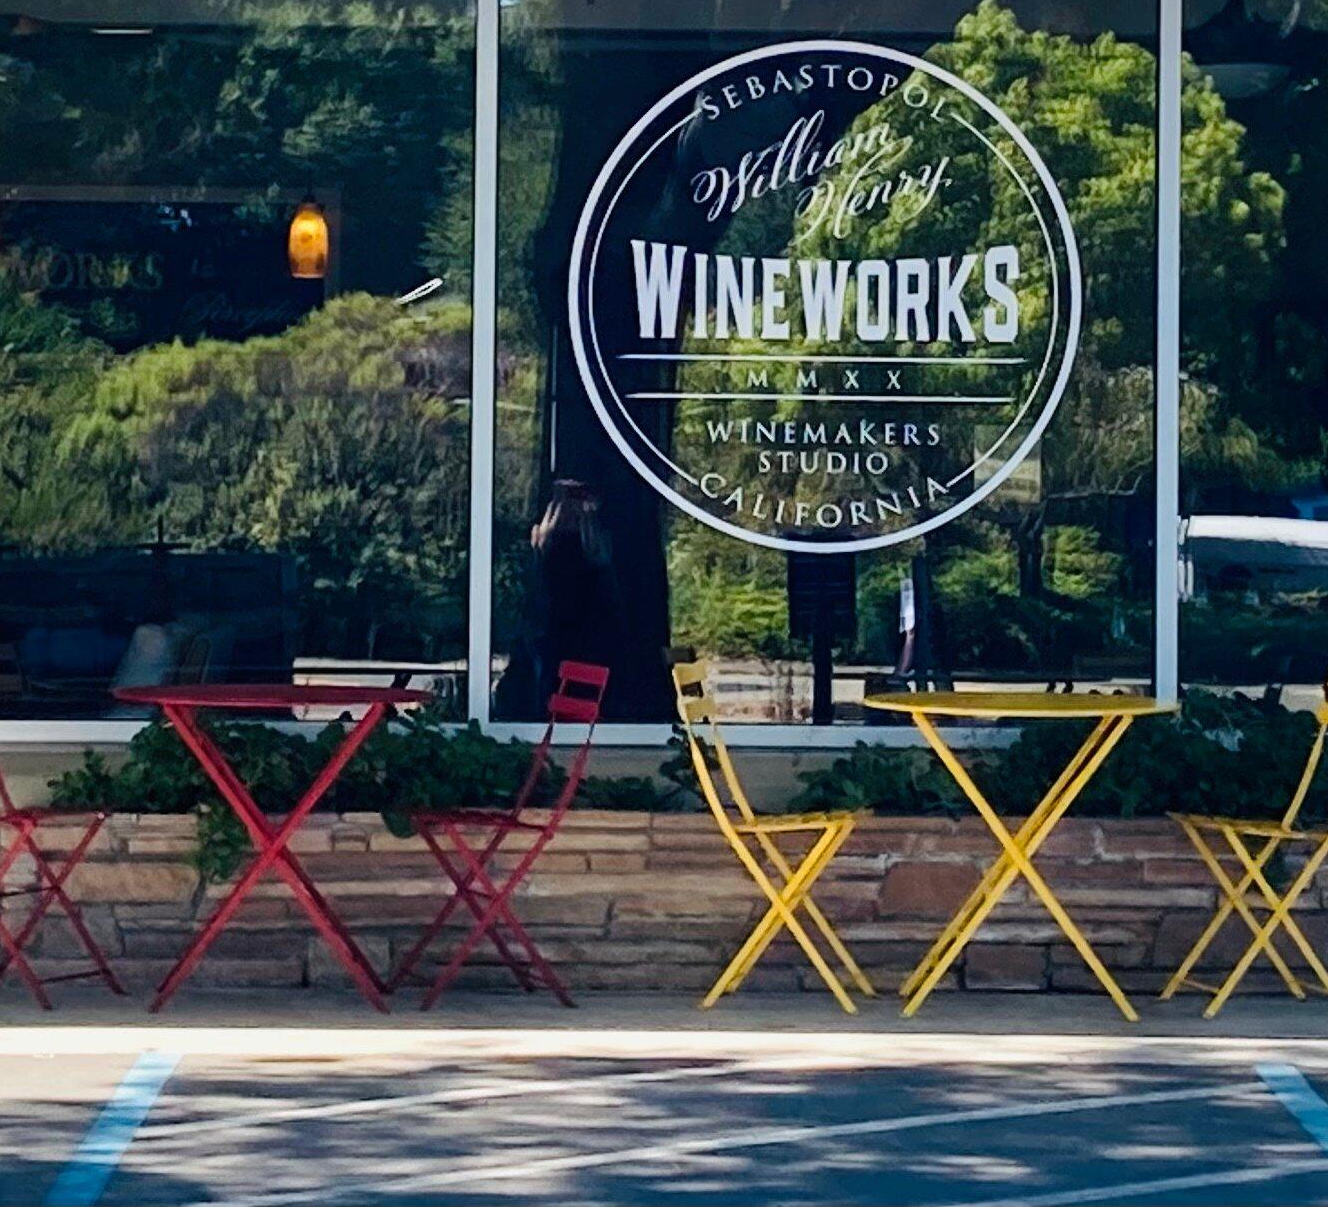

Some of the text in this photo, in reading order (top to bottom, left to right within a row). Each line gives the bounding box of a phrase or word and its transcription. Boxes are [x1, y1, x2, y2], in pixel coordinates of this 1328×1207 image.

[700, 63, 952, 123] SEBASTOPOL
[692, 109, 913, 221] William
[791, 155, 952, 241] Henry
[629, 239, 1020, 343] WINEWORKS
[706, 418, 942, 446] WINEMAKERS
[758, 451, 890, 476] STUDIO
[699, 472, 952, 529] CALIFORNIA
